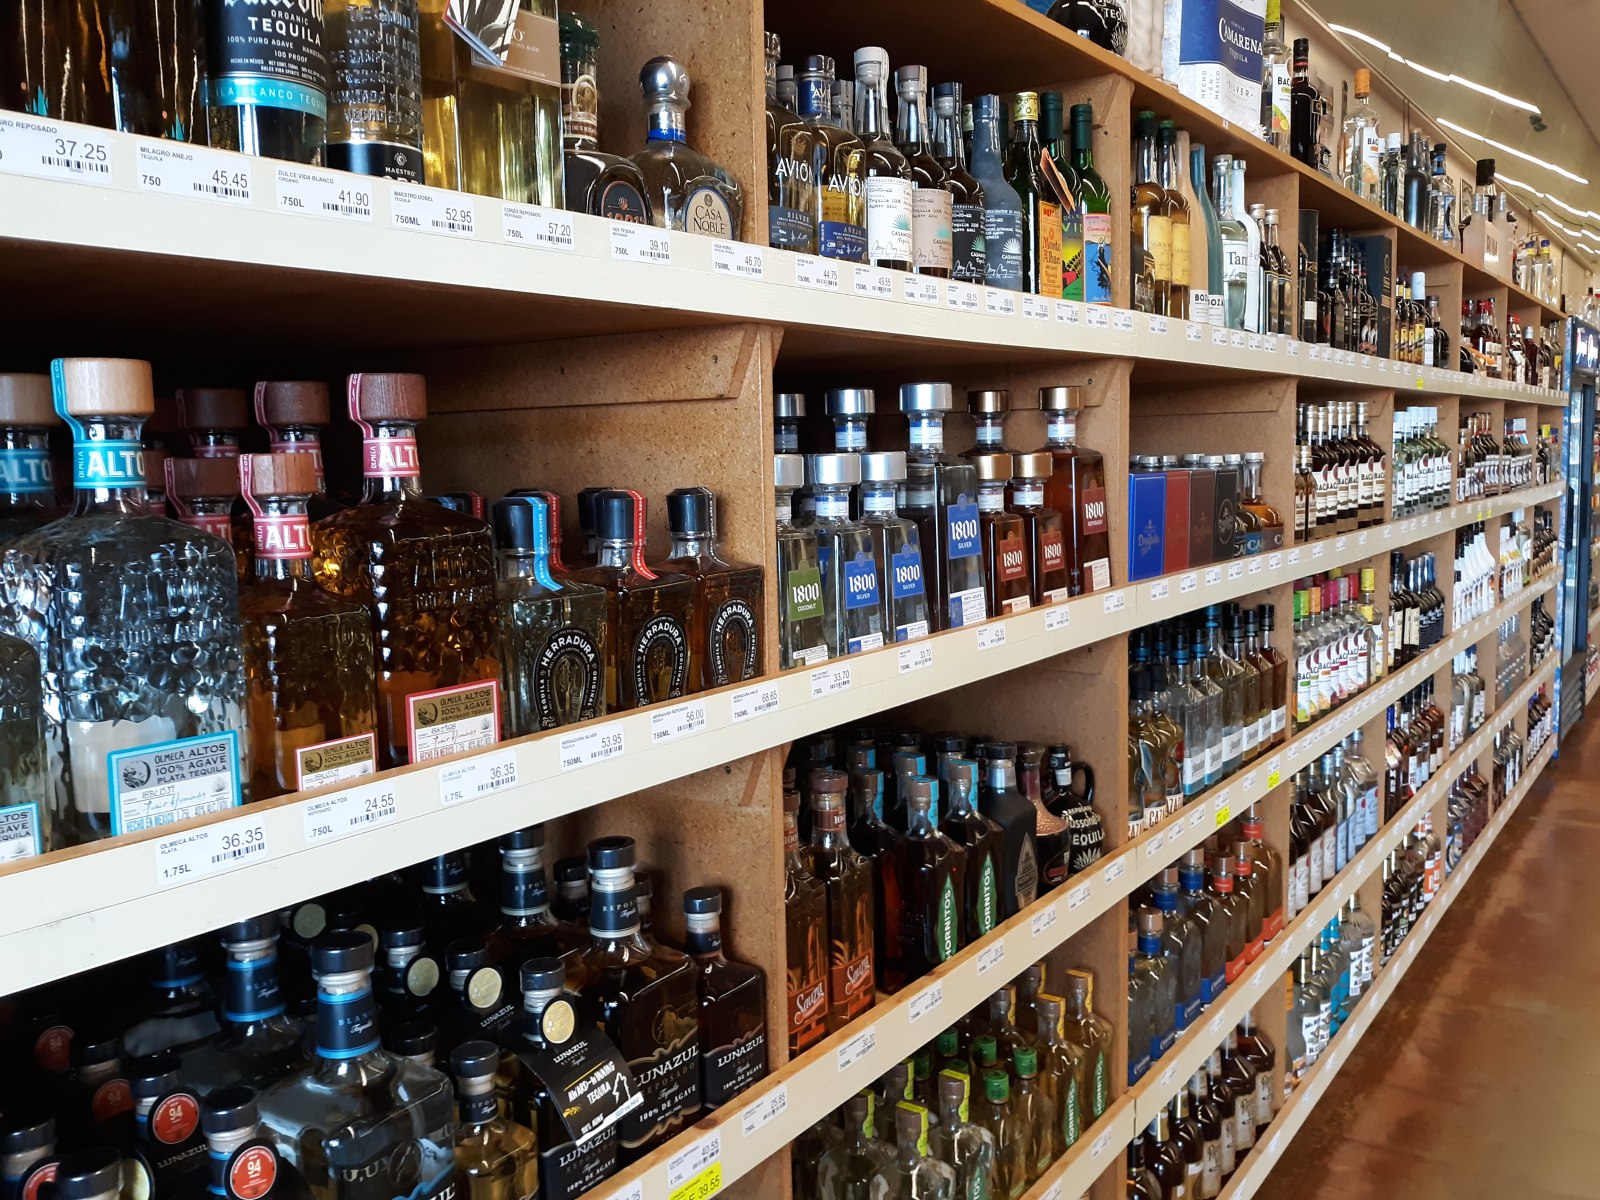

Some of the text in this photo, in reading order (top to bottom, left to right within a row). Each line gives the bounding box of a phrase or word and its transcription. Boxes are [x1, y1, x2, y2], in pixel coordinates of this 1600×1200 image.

[271, 9, 309, 27] ORGANIC
[248, 16, 321, 47] TEQUILA
[1218, 17, 1264, 56] CAMARENA
[227, 35, 294, 49] 100% PURO AGAVE
[274, 49, 308, 64] 100 PROOF
[16, 121, 57, 134] REPOSADO
[55, 138, 107, 161] 37.25
[140, 146, 193, 161] MILAGRO ANEJO
[141, 153, 163, 162] TEQUILA
[212, 170, 248, 188] 45.45
[278, 170, 334, 184] DULCE VIDA BLANCO
[385, 166, 415, 177] MAESTRO
[142, 175, 161, 187] 750
[280, 196, 304, 208] .750L
[339, 190, 369, 207] 41.90
[394, 190, 417, 201] MAESTRO
[395, 214, 420, 226] 750ML
[445, 207, 472, 224] 52.95
[695, 206, 722, 221] CASA
[787, 211, 810, 224] SILVER
[505, 229, 524, 239] .750L
[548, 222, 571, 237] 57.20
[693, 217, 726, 235] NOBLE
[650, 239, 669, 253] 39.10
[745, 255, 762, 268] 46.70
[824, 269, 838, 281] 44.75
[0, 458, 52, 483] ALTO
[87, 450, 145, 478] ALTO
[1084, 501, 1104, 520] 1800
[950, 519, 978, 542] 1800
[957, 541, 973, 550] SILVER
[1044, 542, 1062, 560] 1800
[1002, 550, 1023, 568] 1800
[895, 564, 921, 583] 1800
[848, 572, 876, 593] 1800
[902, 582, 916, 591] SILVER
[792, 582, 820, 604] 1800
[856, 592, 871, 601] SILVER
[797, 603, 817, 613] COCONUT
[716, 602, 754, 633] HERRADURA
[638, 621, 682, 654] HERRADURA
[541, 634, 595, 667] HERRADURA
[675, 652, 684, 687] ORIGINAL
[833, 670, 850, 683] 33.70
[587, 671, 597, 708] ORIGINAL
[636, 663, 645, 702] TEQUILA
[440, 689, 491, 706] OLMECA ALTOS
[540, 678, 549, 719] TEQUILA
[761, 691, 778, 704] 68.65
[441, 699, 491, 716] 100% AGAVE
[686, 708, 704, 722] 56.00
[733, 709, 749, 719] 750ML
[601, 733, 622, 748] 53.95
[653, 729, 671, 740] 750ML
[346, 738, 370, 750] ALTOS
[155, 743, 227, 765] OLMECA ALTOS
[324, 747, 370, 763] 100% AGAVE
[562, 756, 583, 768] 750ML
[155, 755, 227, 776] 100% AGAVE
[490, 762, 515, 780] 36.35
[157, 765, 228, 784] PLATA TEQUILA
[307, 796, 348, 812] OLMECA ALTOS
[365, 793, 395, 812] 24.55
[444, 791, 464, 802] 1.75L
[221, 827, 264, 851] 36.35
[310, 825, 333, 838] .750L
[160, 832, 208, 850] OLMECA ALTOS
[160, 847, 177, 855] PLATA
[163, 863, 191, 878] 1.75L
[845, 955, 871, 995] Sauza
[794, 981, 826, 1026] Sauza
[480, 1004, 514, 1028] LUNAZUL
[553, 1041, 588, 1064] LUNAZUL
[717, 1034, 765, 1068] LUNAZUL
[634, 1043, 699, 1088] LUNAZUL
[746, 1062, 762, 1078] AGAVE
[567, 1061, 616, 1103] AWARD-WINNING
[587, 1082, 611, 1105] TEQUILA
[639, 1084, 697, 1123] 100% DE AGAVE
[169, 1107, 182, 1121] 94
[559, 1126, 617, 1168] LUNAZUL
[701, 1138, 719, 1156] 40.55
[247, 1162, 262, 1176] 94
[698, 1175, 720, 1200] 39.55
